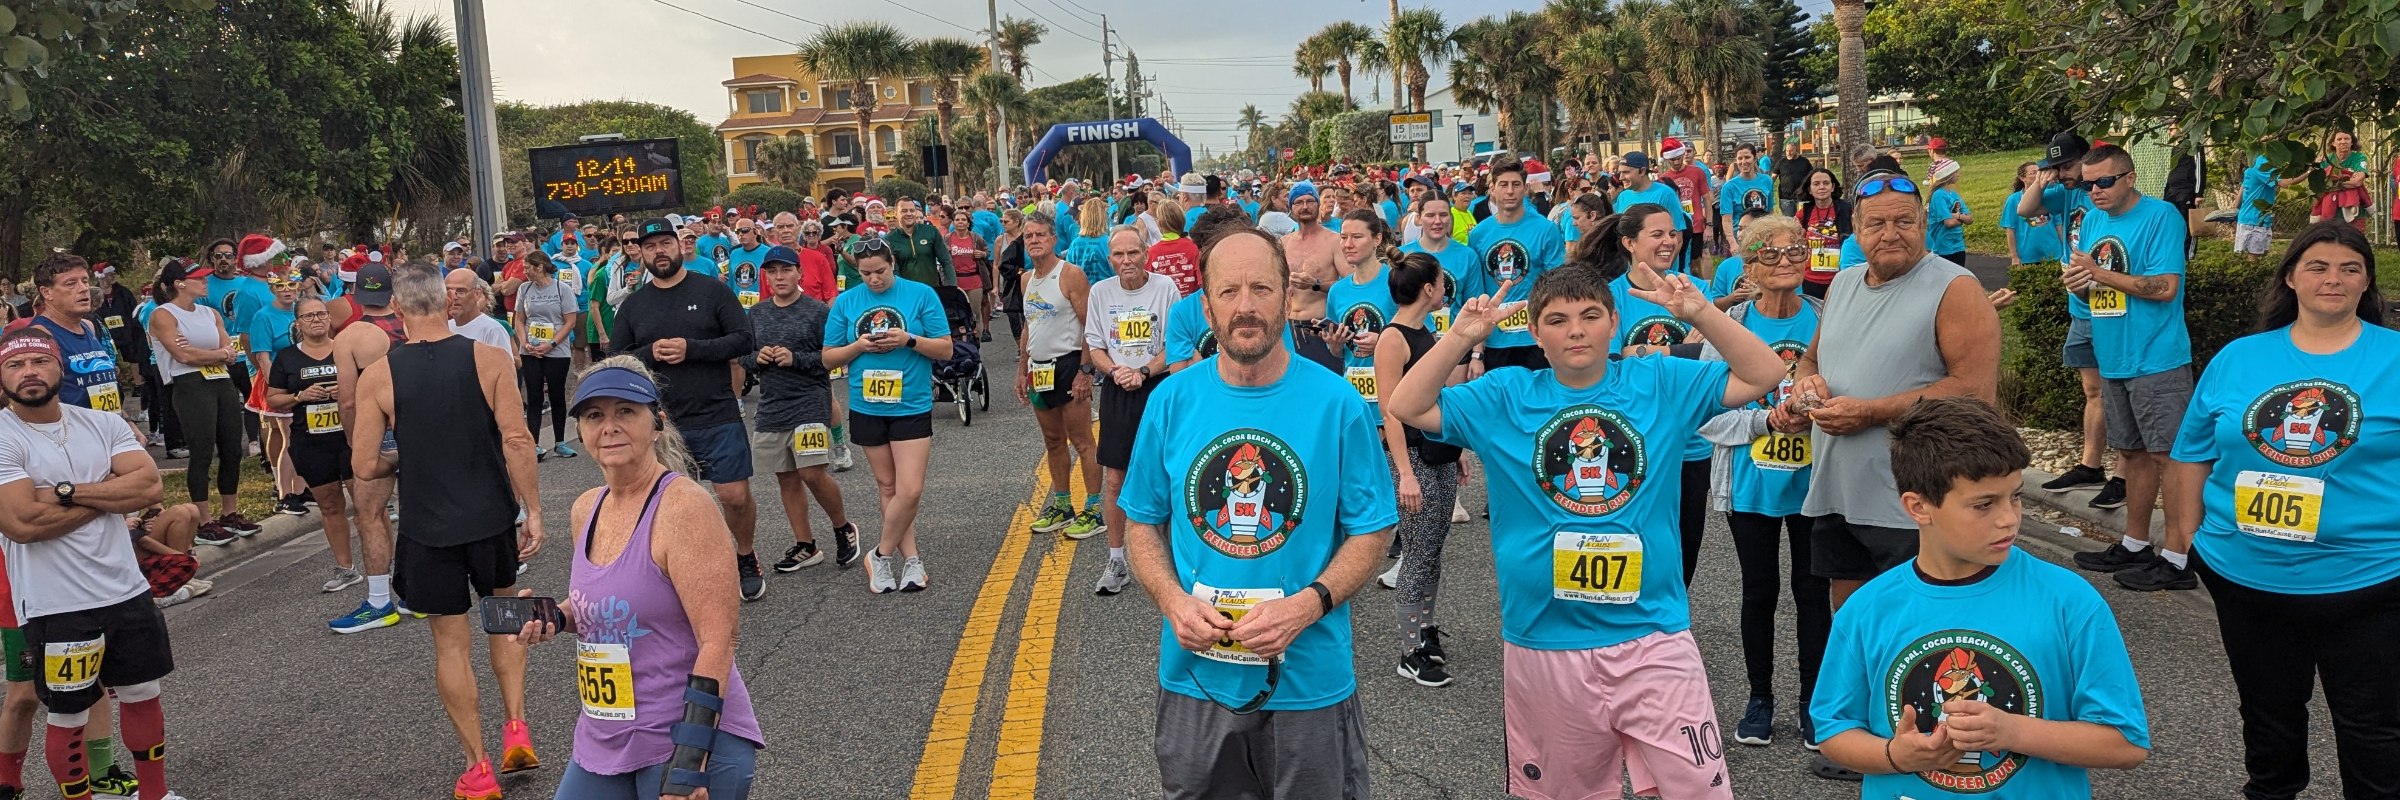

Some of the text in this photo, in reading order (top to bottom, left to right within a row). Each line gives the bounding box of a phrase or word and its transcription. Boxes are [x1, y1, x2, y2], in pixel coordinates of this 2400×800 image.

[1067, 121, 1139, 142] FINISH
[1395, 124, 1405, 133] 15
[576, 156, 636, 178] 12/14
[546, 174, 668, 200] 730-930AM
[1818, 254, 1830, 267] 91
[2094, 290, 2117, 309] 253
[534, 328, 547, 339] 86
[1126, 321, 1150, 339] 402
[869, 379, 895, 396] 467
[1351, 377, 1375, 395] 588
[99, 392, 119, 411] 262
[2247, 411, 2255, 429] NORTH
[2291, 381, 2313, 389] COCOA
[2314, 381, 2336, 389] BEACH
[314, 411, 341, 428] 270
[1562, 409, 1584, 419] COCOA
[1585, 408, 1607, 417] BEACH
[1551, 417, 1563, 429] PAL,
[1621, 424, 1635, 438] CAPE
[2290, 422, 2312, 435] 5K
[801, 433, 825, 448] 449
[1538, 428, 1552, 454] BEACHES
[1762, 436, 1804, 462] 486
[1633, 437, 1644, 475] CANAVERAL
[2259, 443, 2337, 466] REINDEER RUN
[1189, 433, 1304, 516] NORTH BEACHES PAL, COCOA BEACH PD & CAPE CANAVERAL
[1536, 454, 1544, 478] NORTH
[1580, 465, 1602, 479] 5K
[1234, 501, 1256, 517] 5K
[1554, 489, 1630, 514] REINDEER RUN
[2247, 492, 2303, 527] 405
[1203, 529, 1286, 555] REINDEER RUN
[1569, 555, 1627, 589] 407
[1220, 590, 1247, 598] RUN
[569, 589, 630, 629] Stay
[1922, 636, 1953, 650] COCOA
[1956, 636, 1989, 648] BEACH
[1989, 644, 2004, 655] PD
[1200, 650, 1272, 662] www.Run4aCause.or
[1905, 648, 1923, 664] PAL,
[57, 652, 100, 682] 412
[2011, 660, 2030, 683] CAPE
[578, 666, 617, 705] 555
[1890, 663, 1907, 701] BEACHES
[2025, 682, 2037, 718] CANAV
[1890, 703, 1901, 727] RTH
[1680, 720, 1722, 765] 10
[1923, 758, 2017, 789] INDEER RUN
